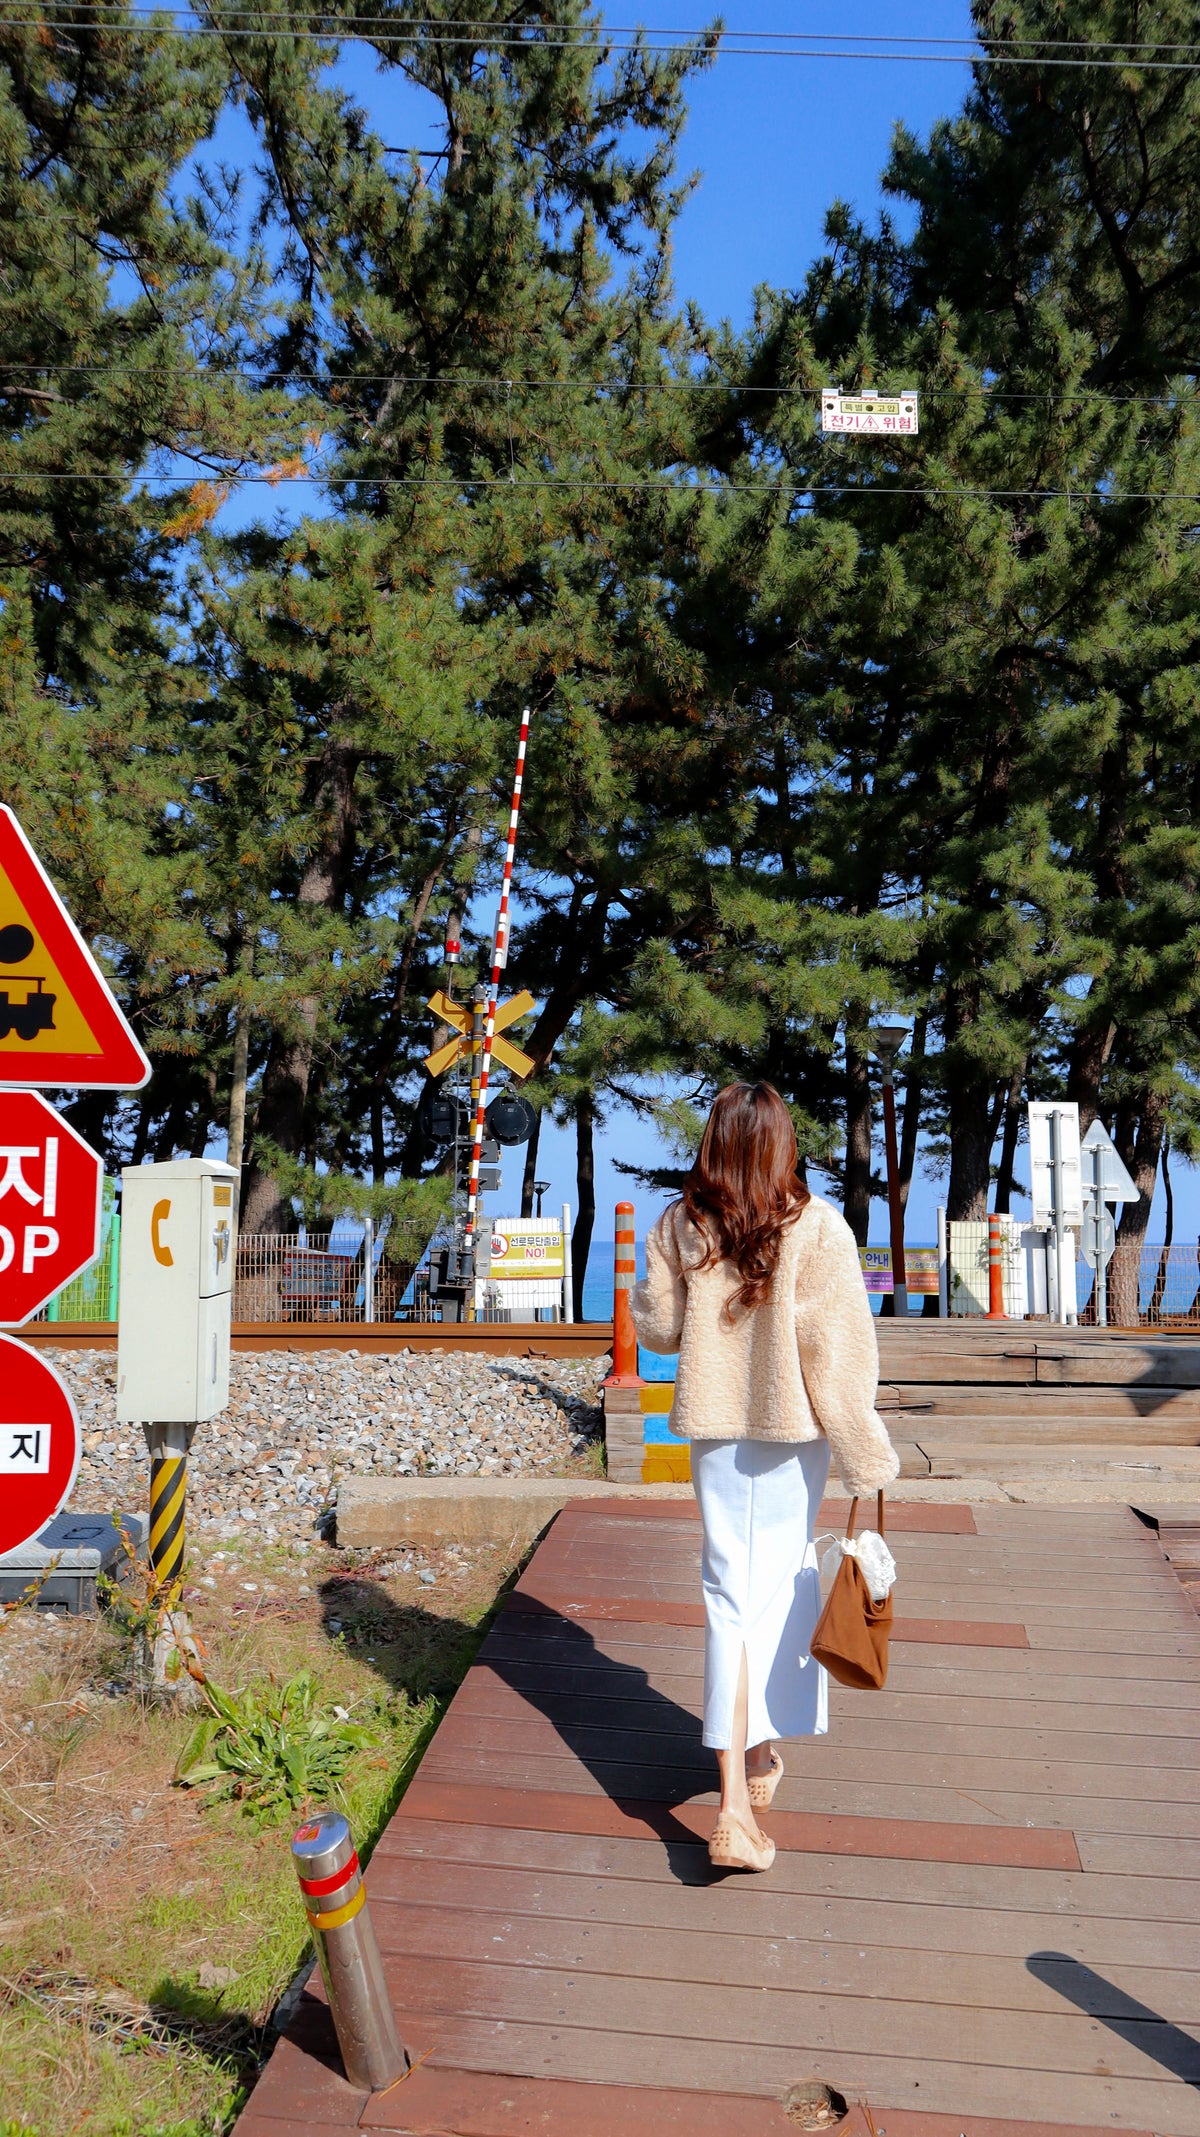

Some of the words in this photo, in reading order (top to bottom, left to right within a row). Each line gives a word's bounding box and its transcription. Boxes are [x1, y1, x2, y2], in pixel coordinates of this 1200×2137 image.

[877, 405, 895, 413] 고압
[831, 415, 859, 428] 전기
[883, 416, 911, 429] 위험
[0, 1136, 59, 1217] 지
[525, 1248, 545, 1258] NO!
[865, 1253, 889, 1268] 안내
[9, 1430, 41, 1464] 지
